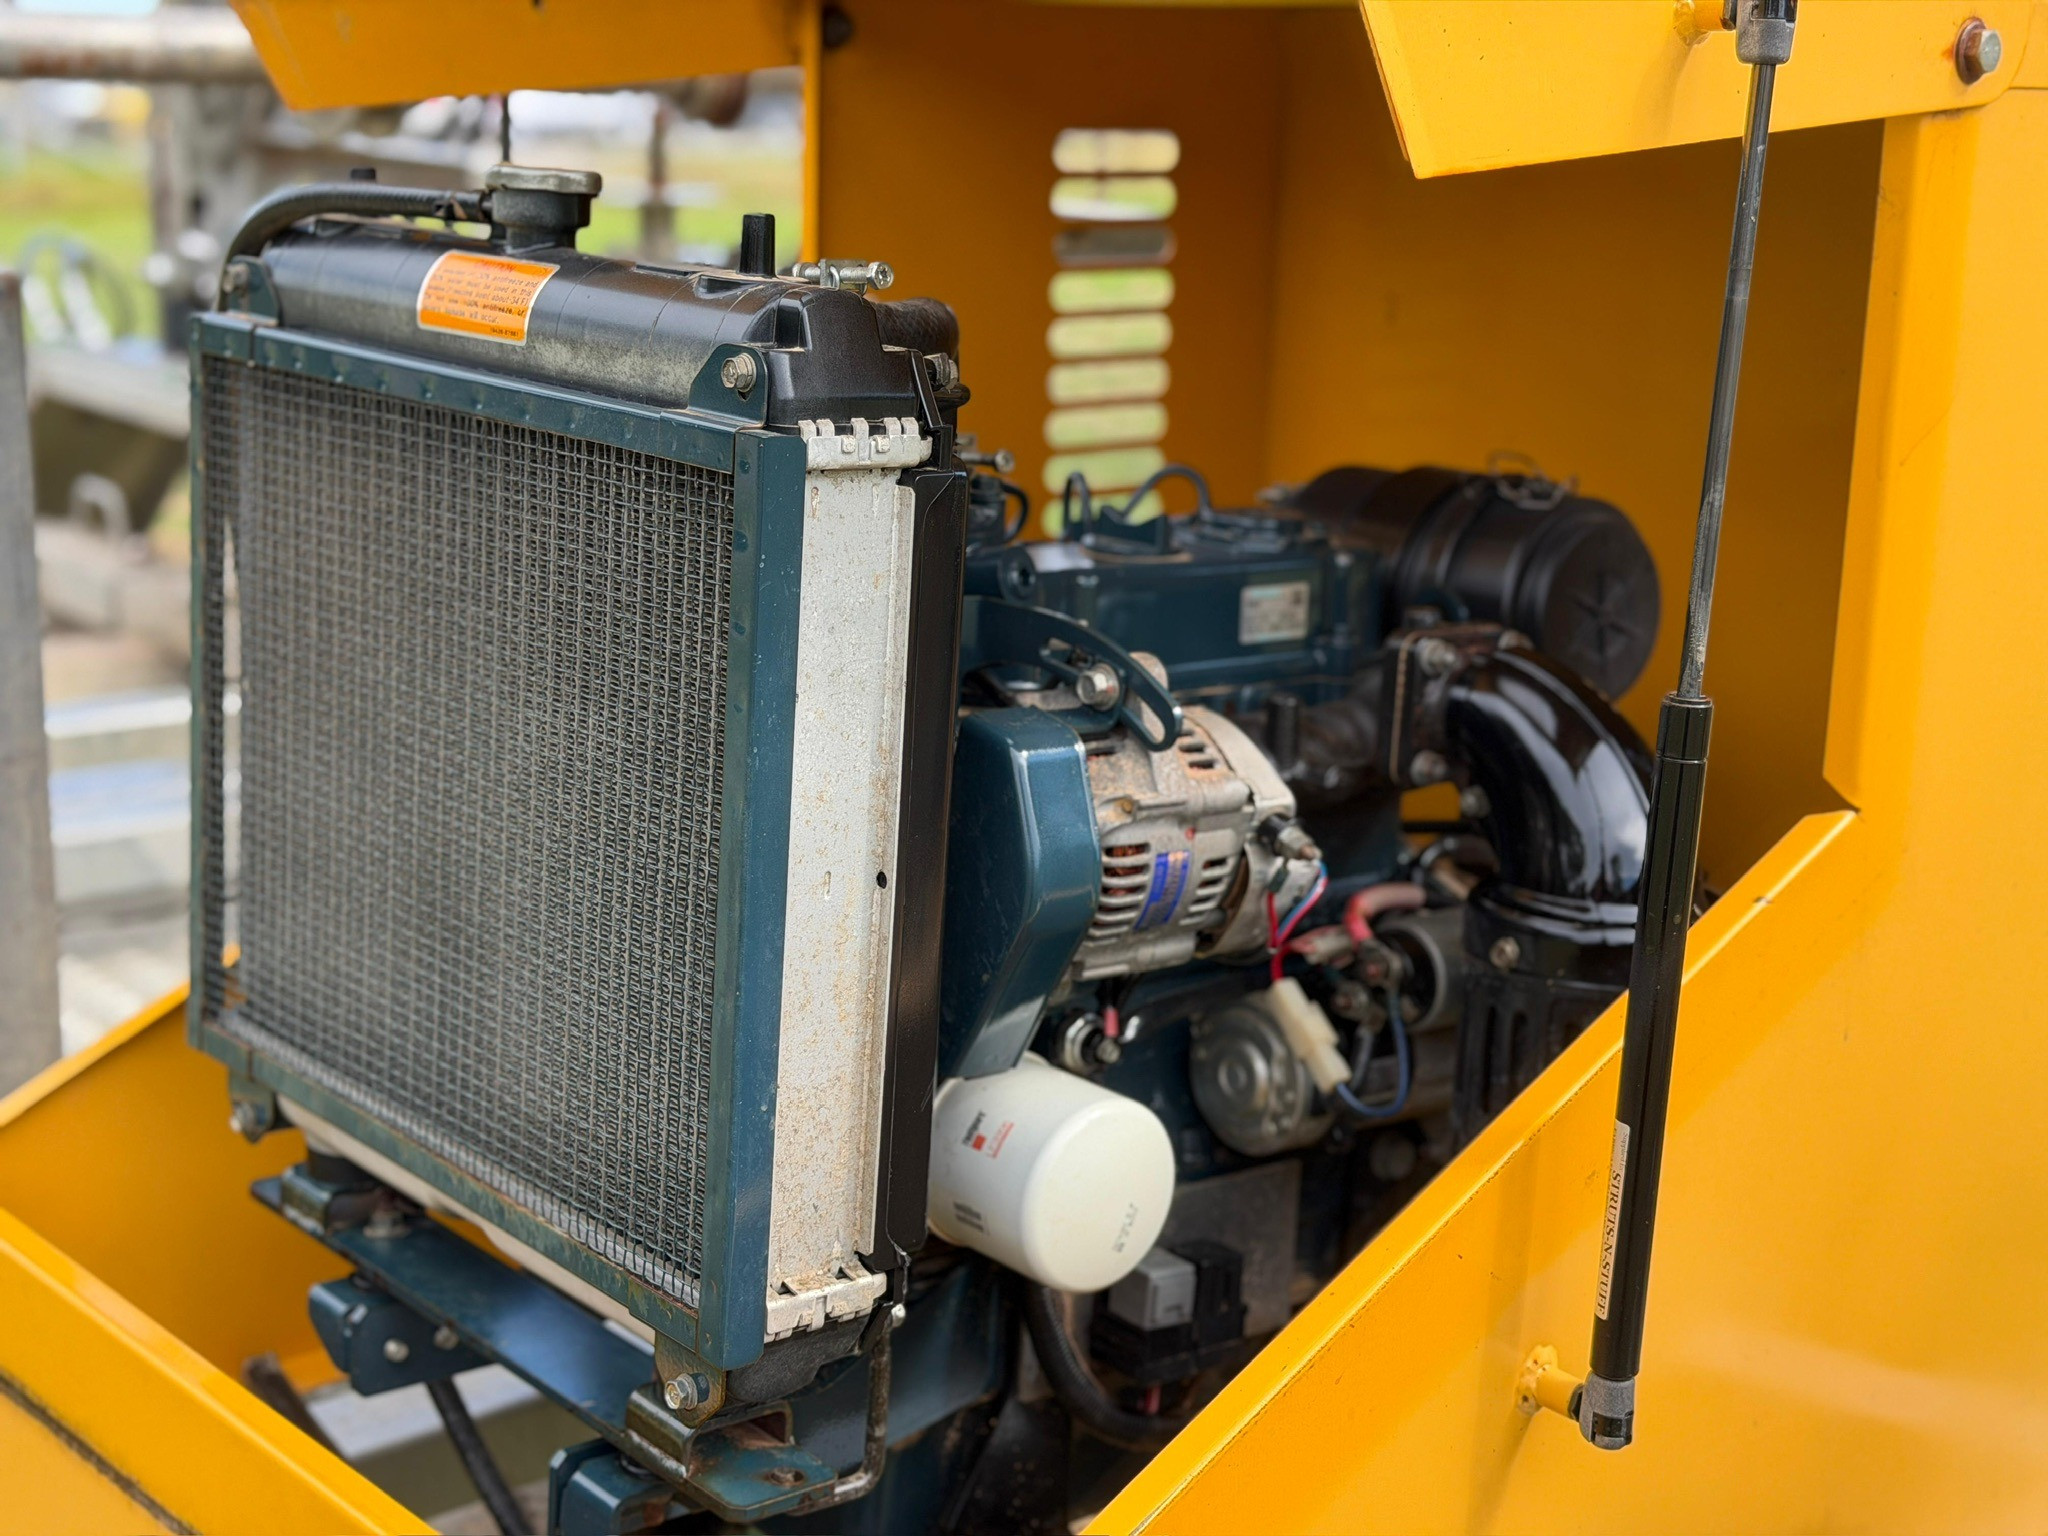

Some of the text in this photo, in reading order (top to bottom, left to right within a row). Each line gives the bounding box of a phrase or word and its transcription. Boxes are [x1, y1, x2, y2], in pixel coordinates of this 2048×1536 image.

[525, 280, 539, 288] and
[519, 288, 532, 297] this
[1597, 1170, 1621, 1316] STRUTS-N-STUFF
